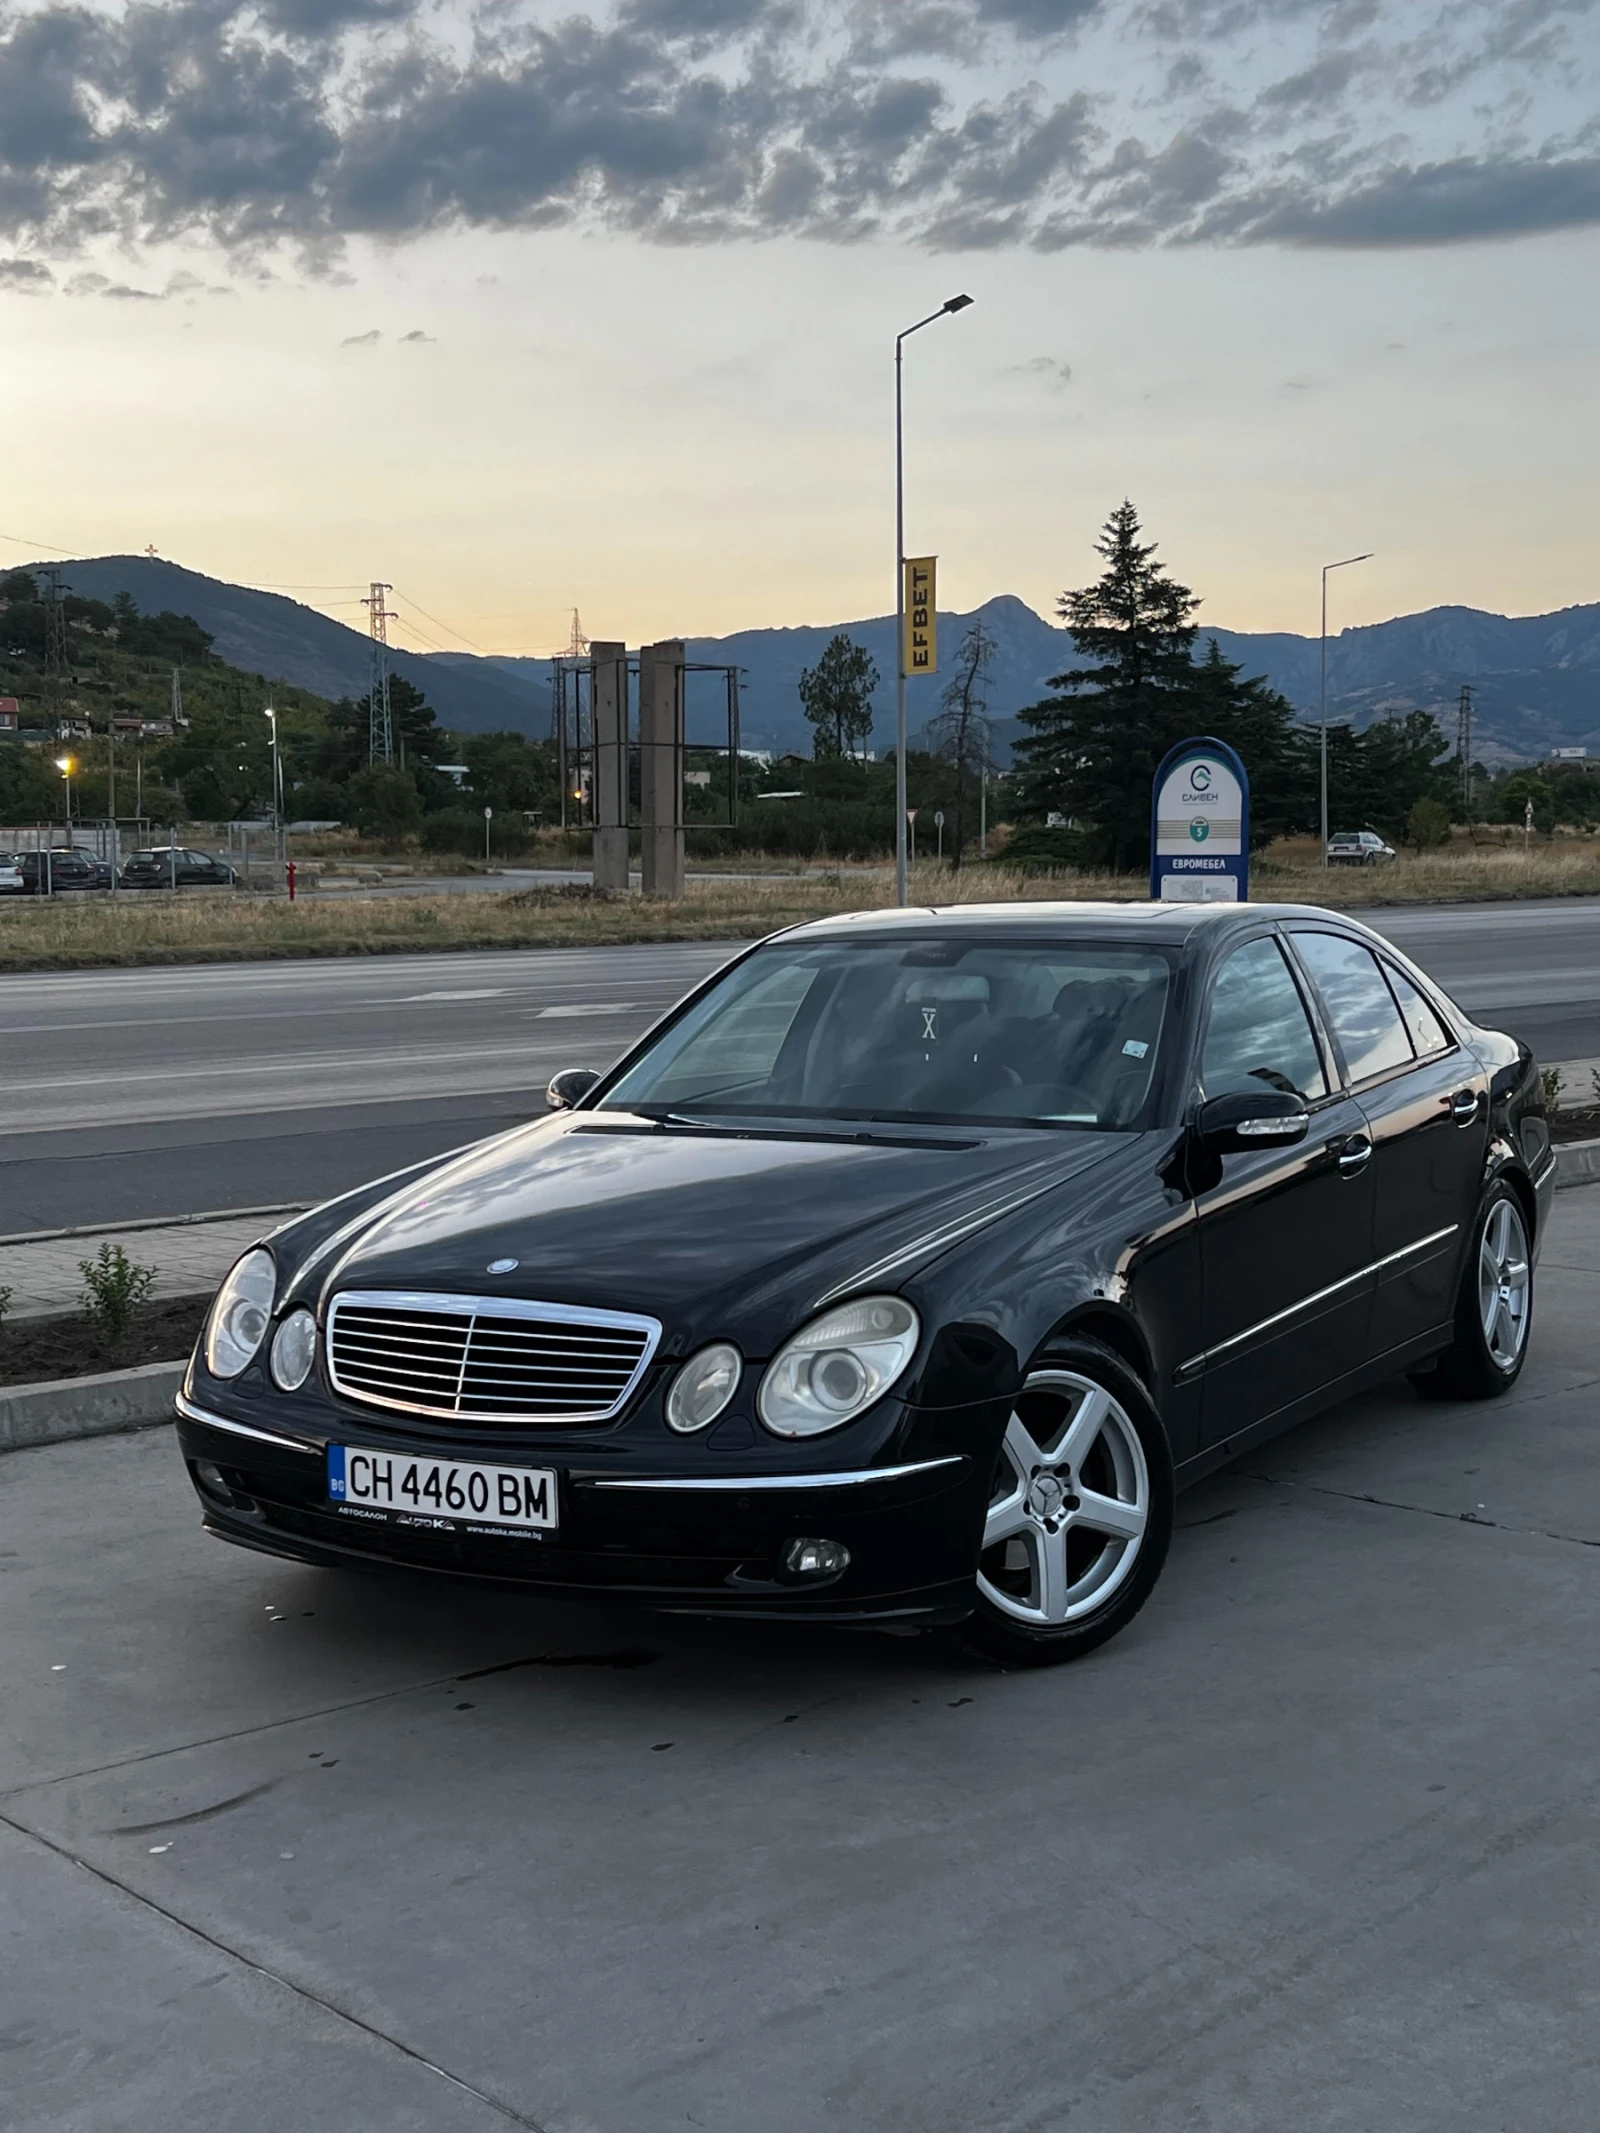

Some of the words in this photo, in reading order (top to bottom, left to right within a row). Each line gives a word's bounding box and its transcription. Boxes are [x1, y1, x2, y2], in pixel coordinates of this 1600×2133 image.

[913, 567, 928, 667] EFBET
[1172, 858, 1226, 870] ЕВРОМЕБЕЛ
[331, 1478, 345, 1492] BG
[401, 1463, 489, 1513] 4460
[338, 1506, 388, 1521] АВТОСАЛОН
